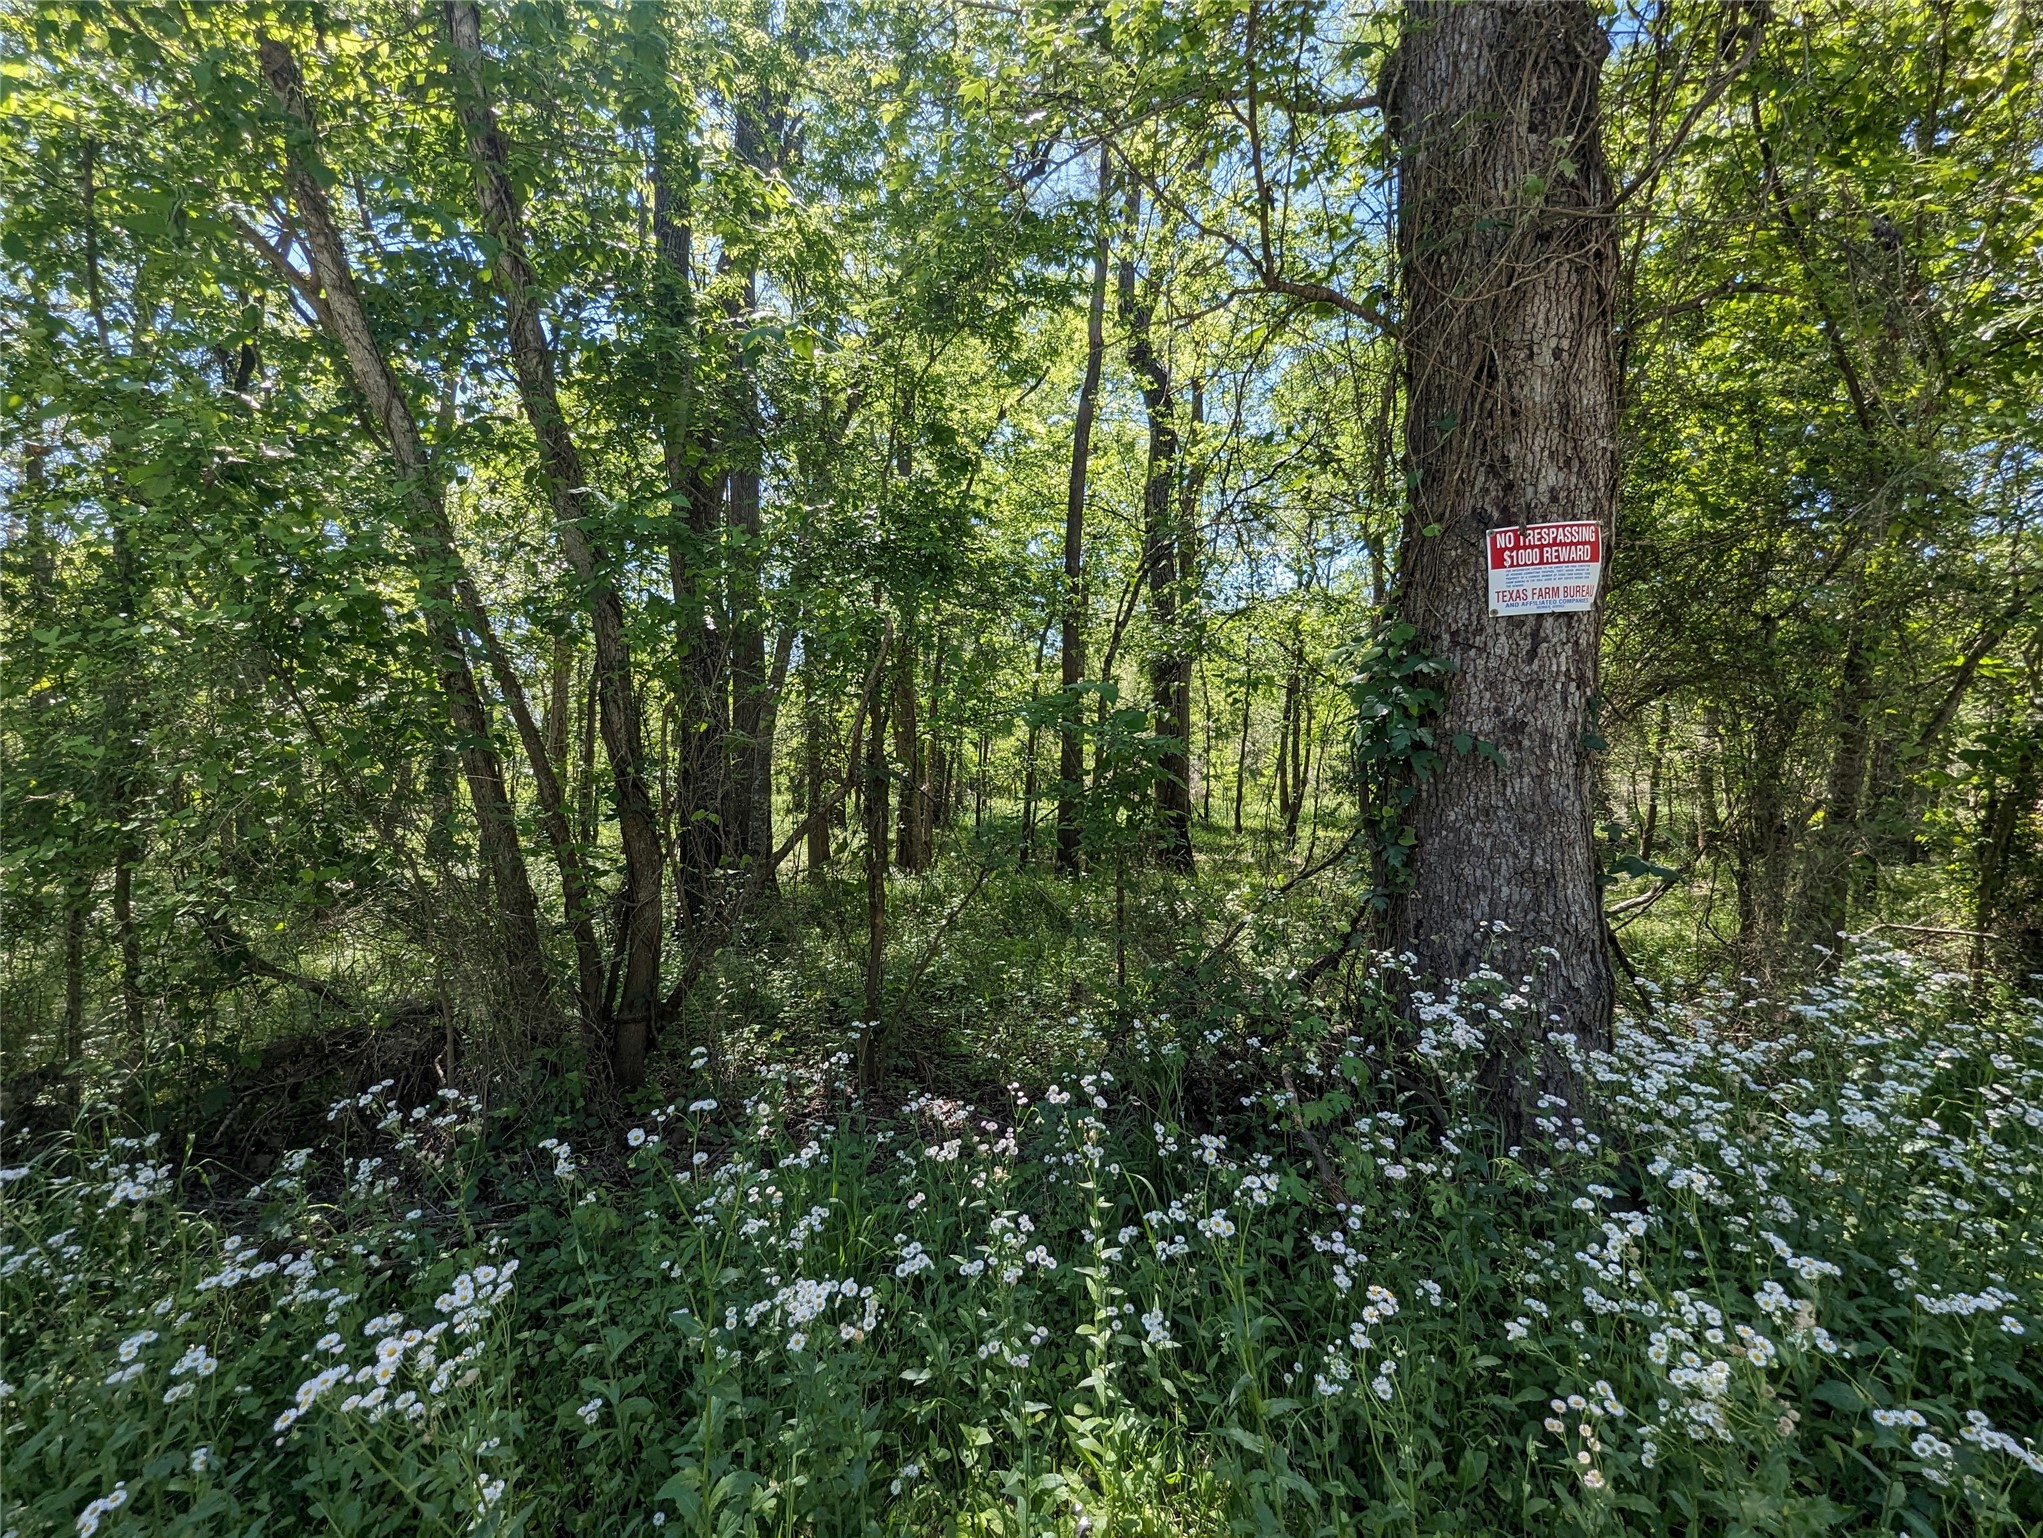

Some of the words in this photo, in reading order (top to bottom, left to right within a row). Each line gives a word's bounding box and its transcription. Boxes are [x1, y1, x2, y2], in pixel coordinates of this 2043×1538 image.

[1496, 532, 1514, 548] NO
[1518, 526, 1595, 546] TRESPASSING
[1503, 548, 1539, 567] $1000
[1543, 545, 1591, 563] REWARD
[1495, 588, 1528, 603] TEXAS
[1532, 586, 1560, 600] FARM
